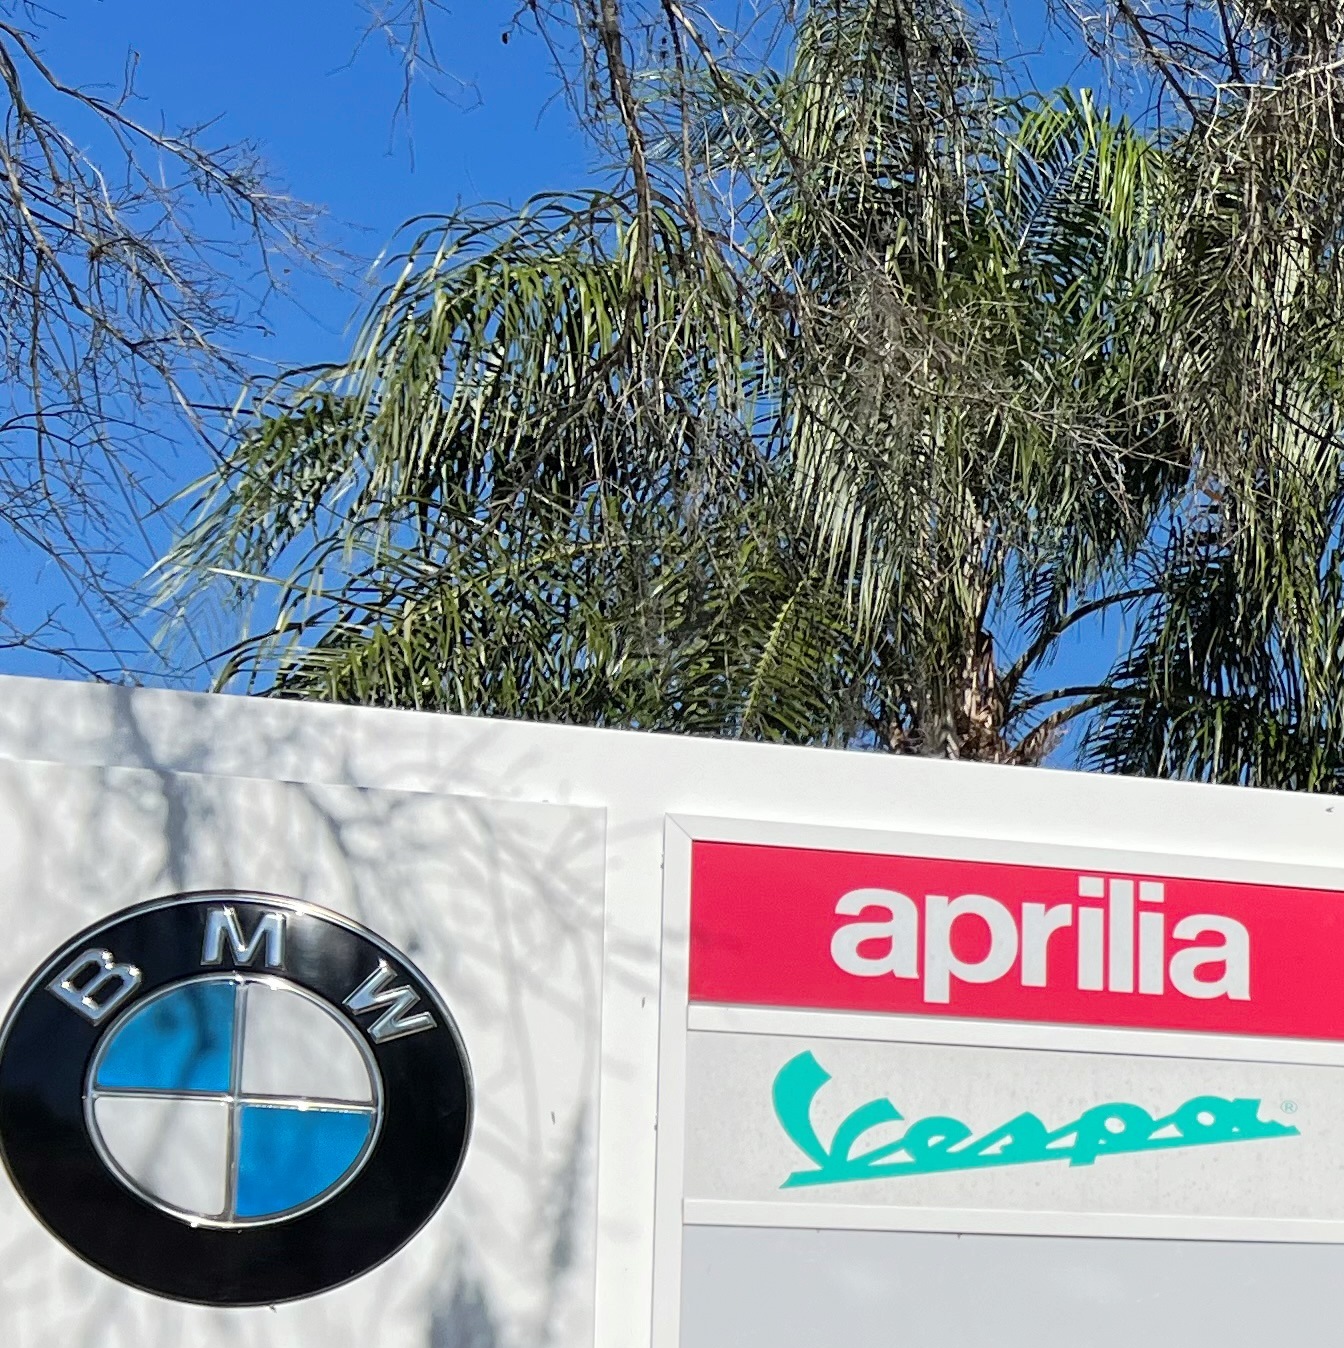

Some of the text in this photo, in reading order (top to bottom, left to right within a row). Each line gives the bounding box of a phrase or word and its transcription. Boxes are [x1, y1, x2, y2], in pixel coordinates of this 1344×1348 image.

[48, 903, 437, 1045] BMW
[828, 876, 1252, 1005] aprilia
[770, 1049, 1302, 1190] Vespa
